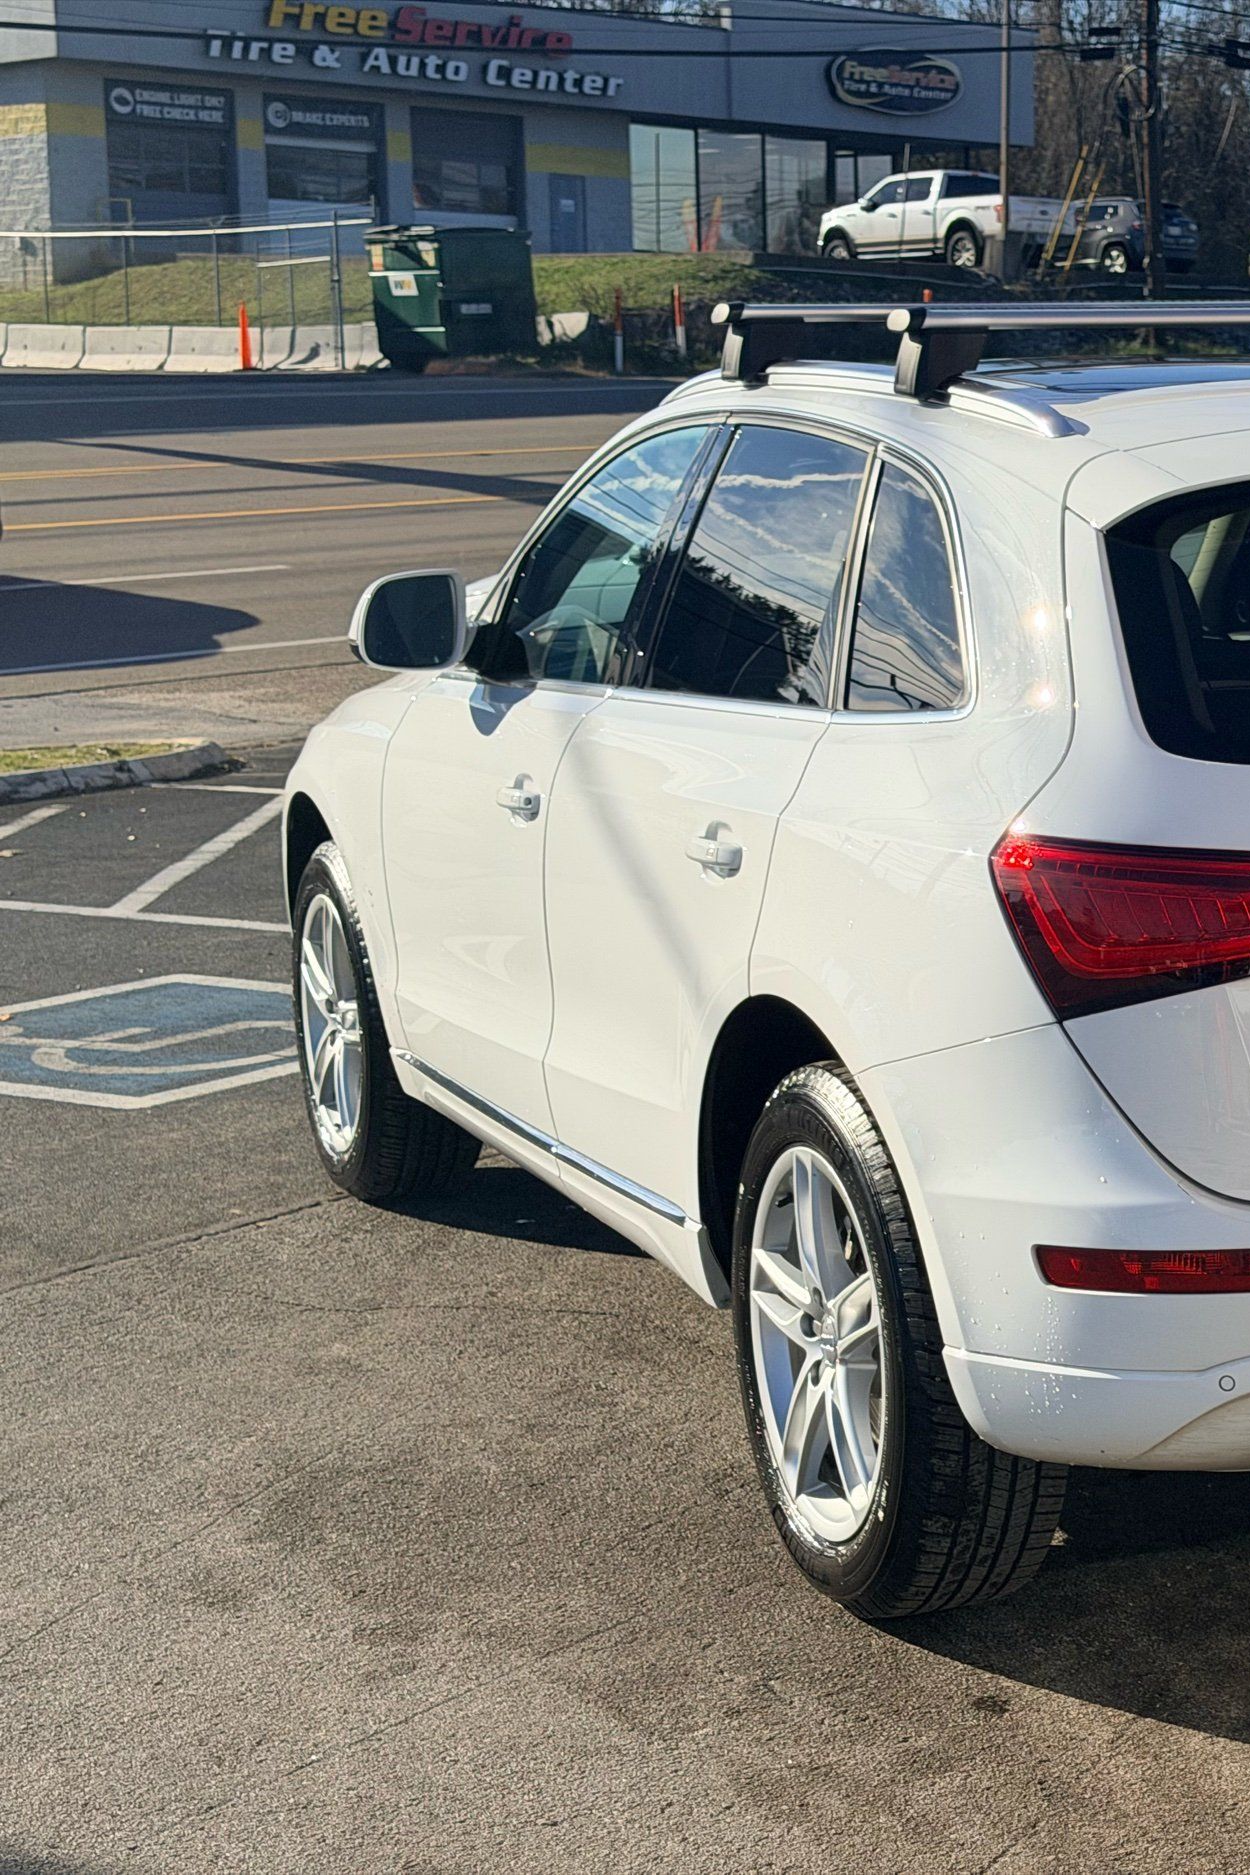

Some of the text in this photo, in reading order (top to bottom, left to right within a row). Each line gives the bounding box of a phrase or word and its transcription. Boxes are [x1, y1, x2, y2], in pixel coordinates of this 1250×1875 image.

[206, 29, 624, 97] Tire & Auto Center
